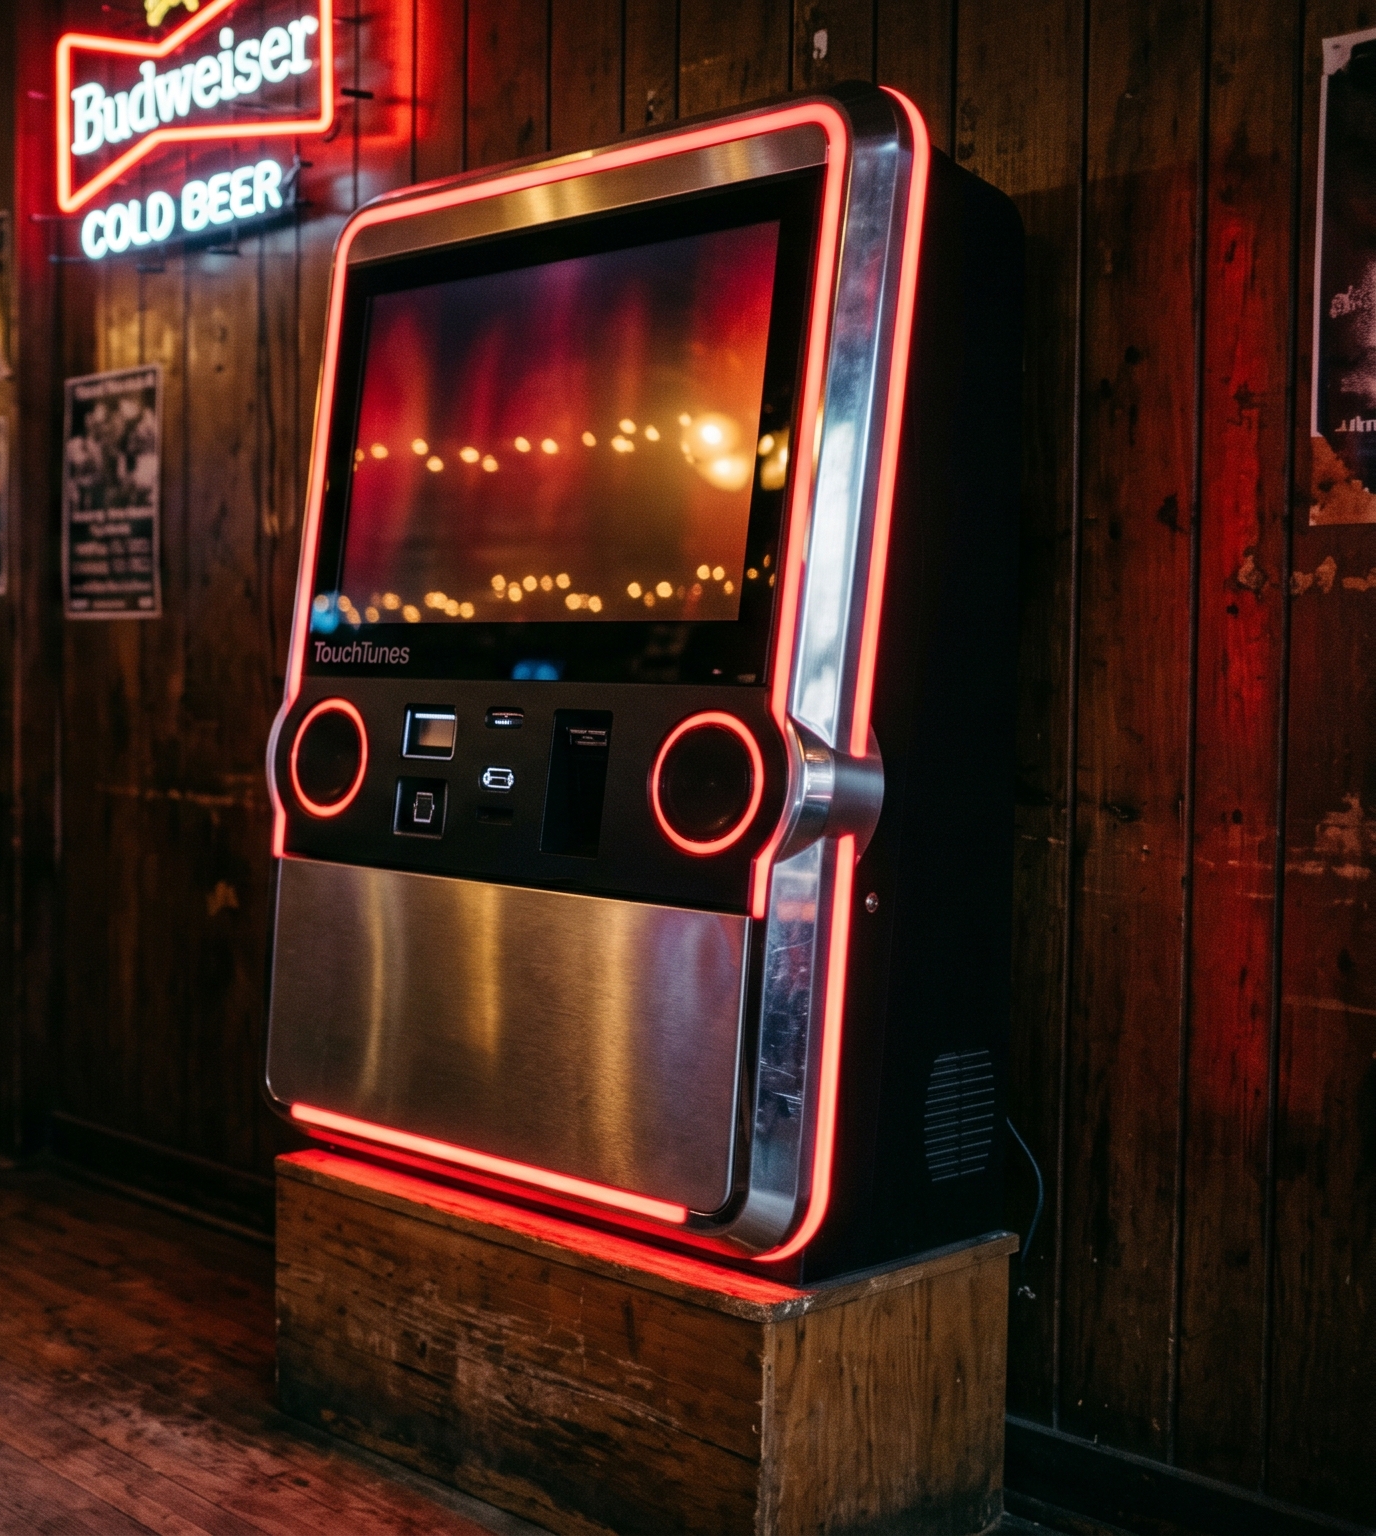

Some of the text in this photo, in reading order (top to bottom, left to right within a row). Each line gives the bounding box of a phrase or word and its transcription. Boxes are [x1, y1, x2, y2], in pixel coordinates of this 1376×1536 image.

[71, 15, 319, 155] Budweiser
[82, 160, 282, 259] COLD BEER
[314, 641, 410, 664] TouchTunes
